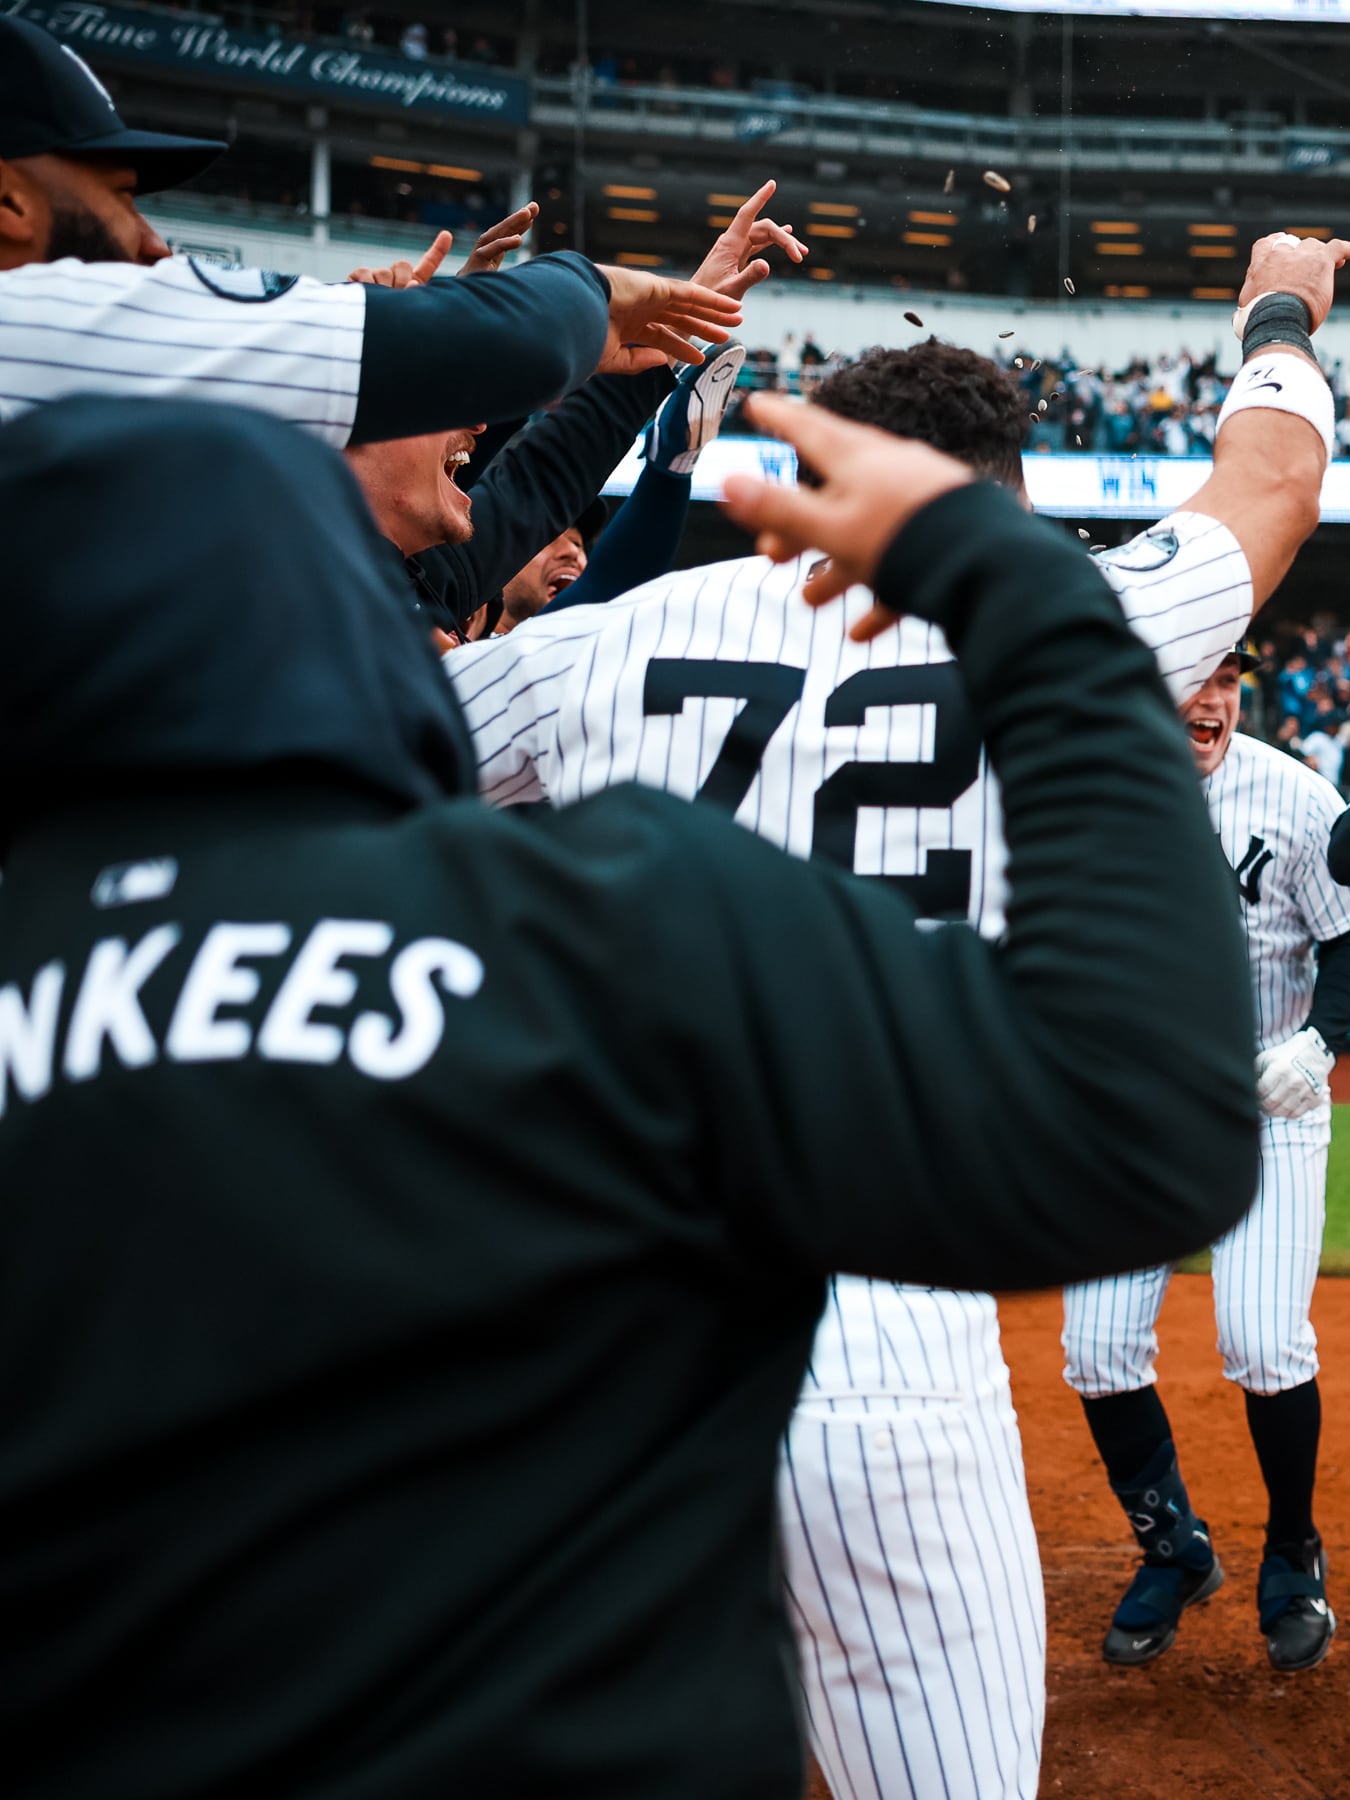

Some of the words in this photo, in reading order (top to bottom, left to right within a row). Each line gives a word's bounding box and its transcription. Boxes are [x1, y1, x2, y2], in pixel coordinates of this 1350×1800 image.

[171, 24, 307, 75] World
[309, 50, 508, 110] Champions
[643, 657, 983, 922] 72
